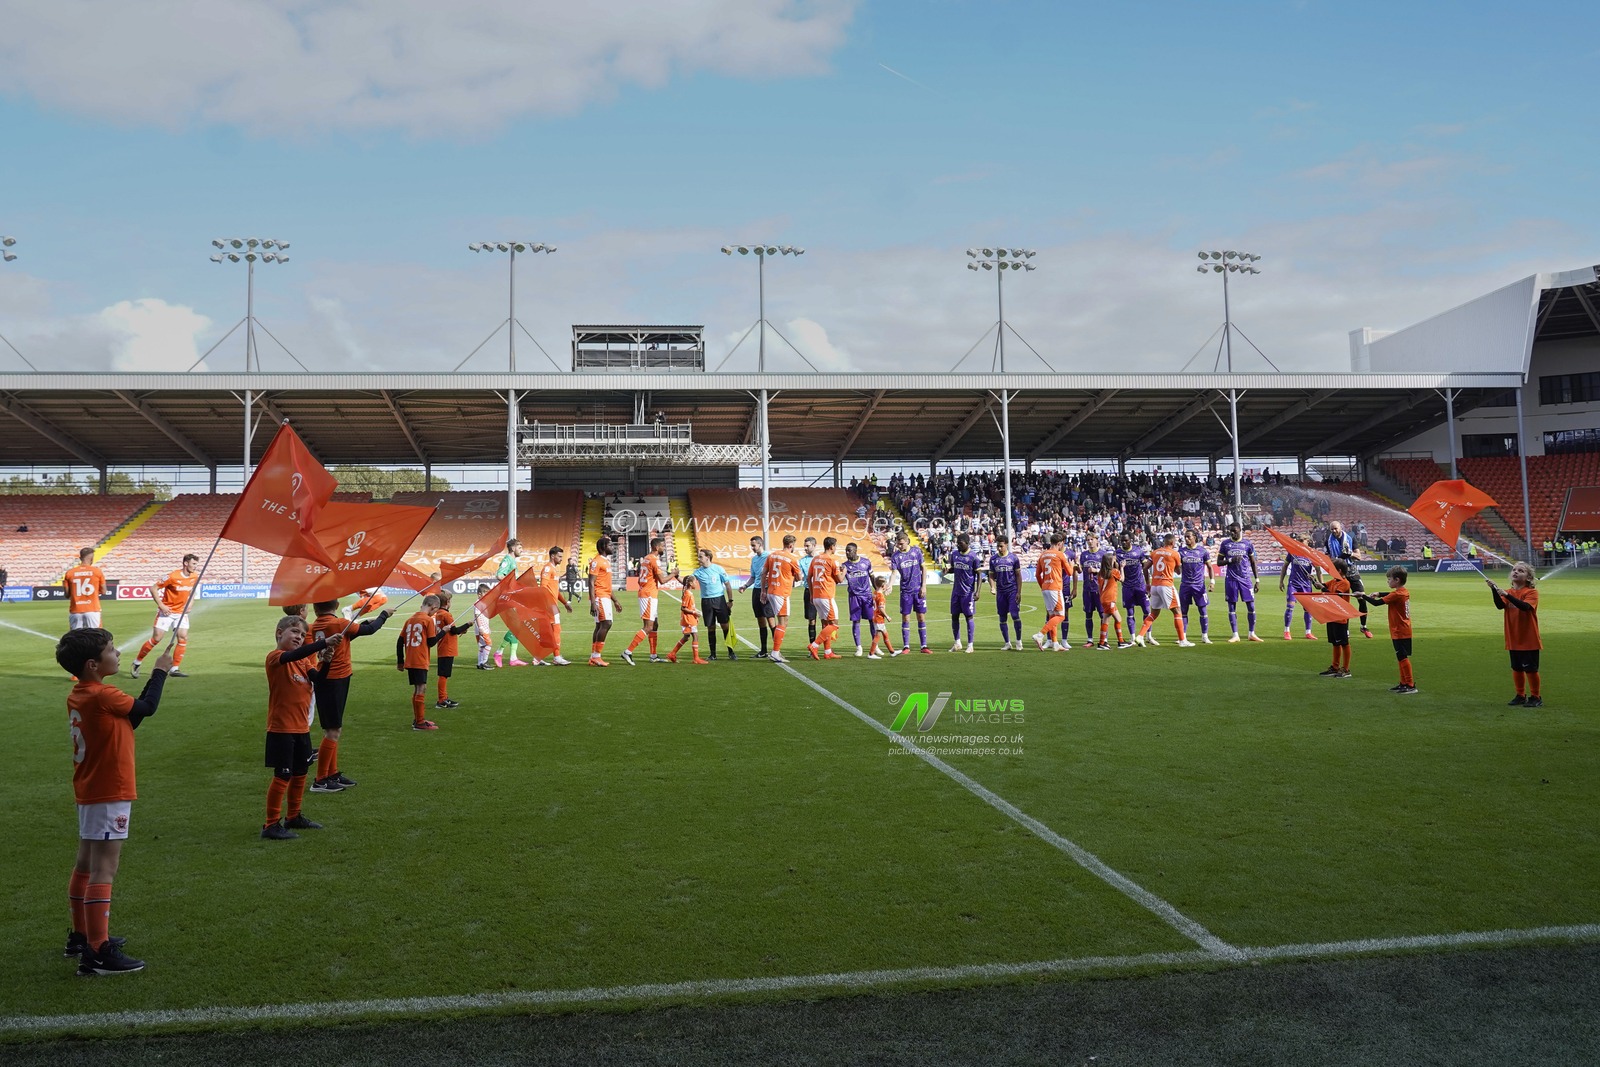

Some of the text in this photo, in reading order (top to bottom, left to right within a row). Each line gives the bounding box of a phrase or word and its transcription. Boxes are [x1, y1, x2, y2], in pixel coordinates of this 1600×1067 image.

[261, 499, 287, 515] THE
[771, 561, 782, 579] 5
[1043, 559, 1052, 575] 3
[1156, 556, 1165, 572] 6
[73, 578, 95, 597] 16
[405, 623, 423, 647] 13
